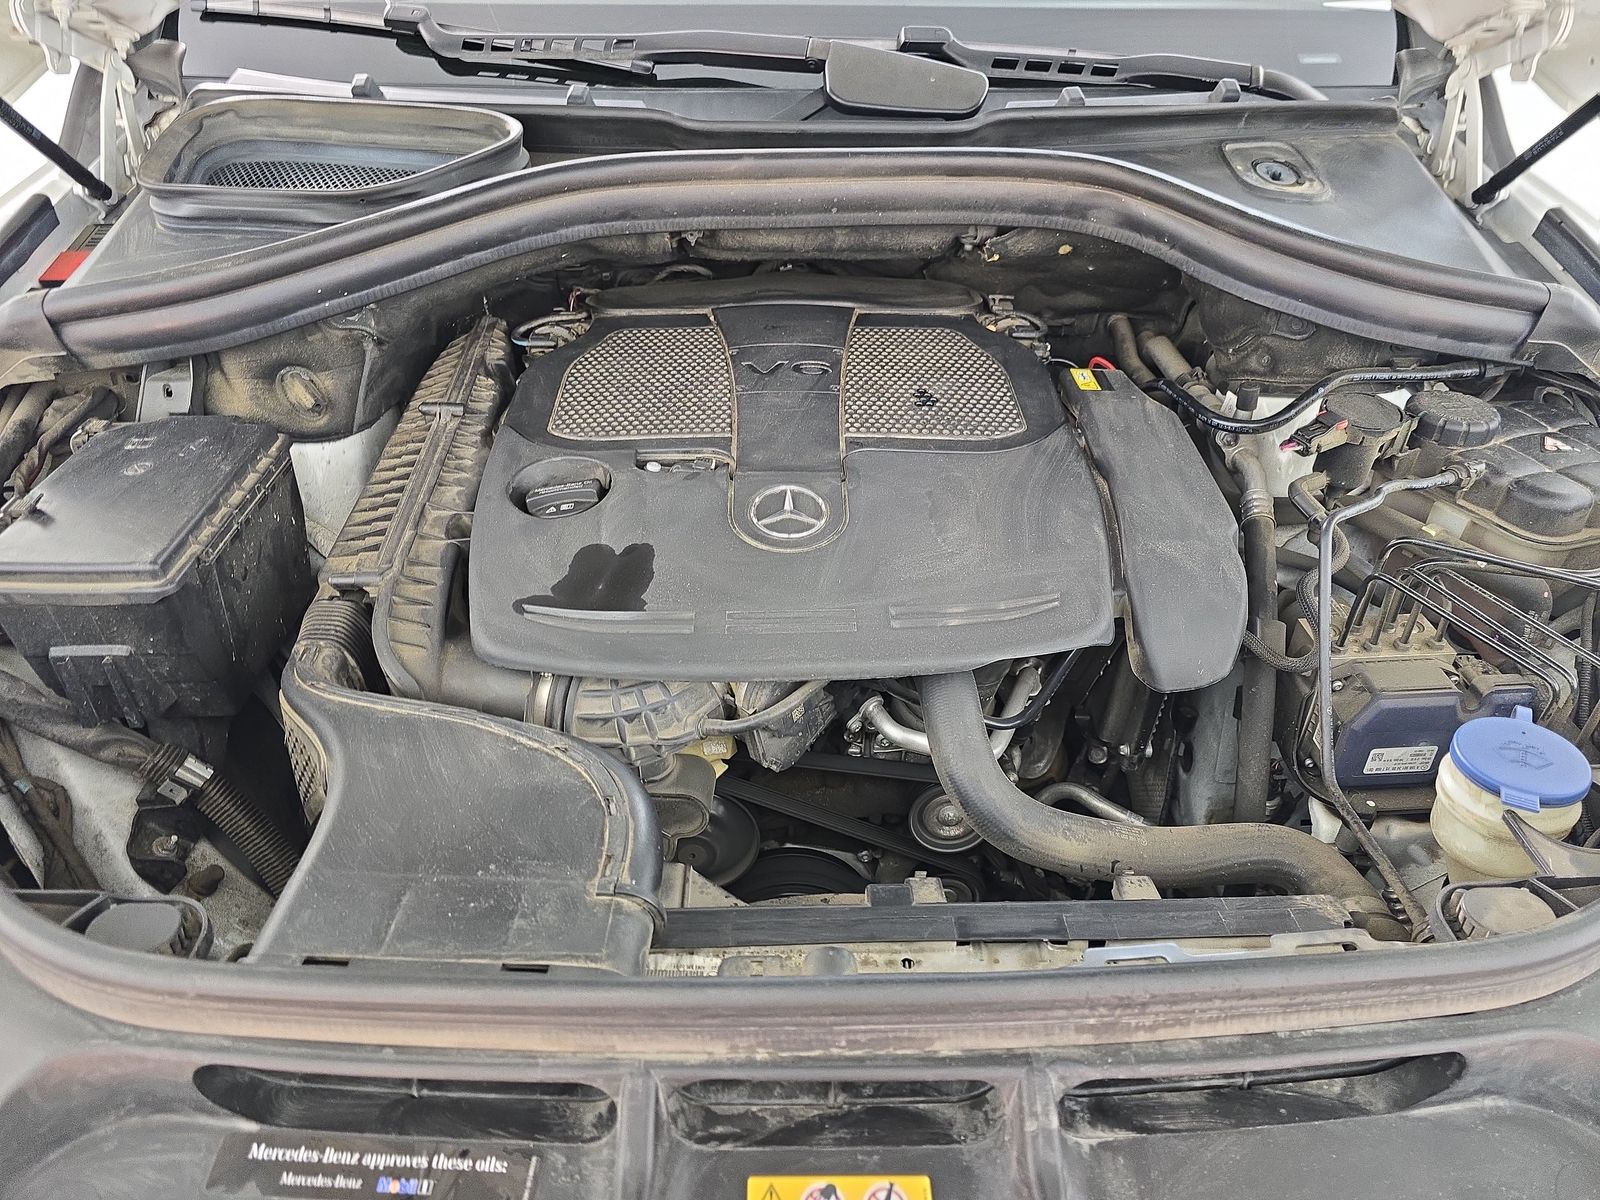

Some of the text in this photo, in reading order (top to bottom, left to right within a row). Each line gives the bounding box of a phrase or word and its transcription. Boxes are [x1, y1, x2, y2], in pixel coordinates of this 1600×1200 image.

[248, 1142, 509, 1174] Mercedes-Benz approves these oils:
[280, 1171, 363, 1189] Mercedes-Benz
